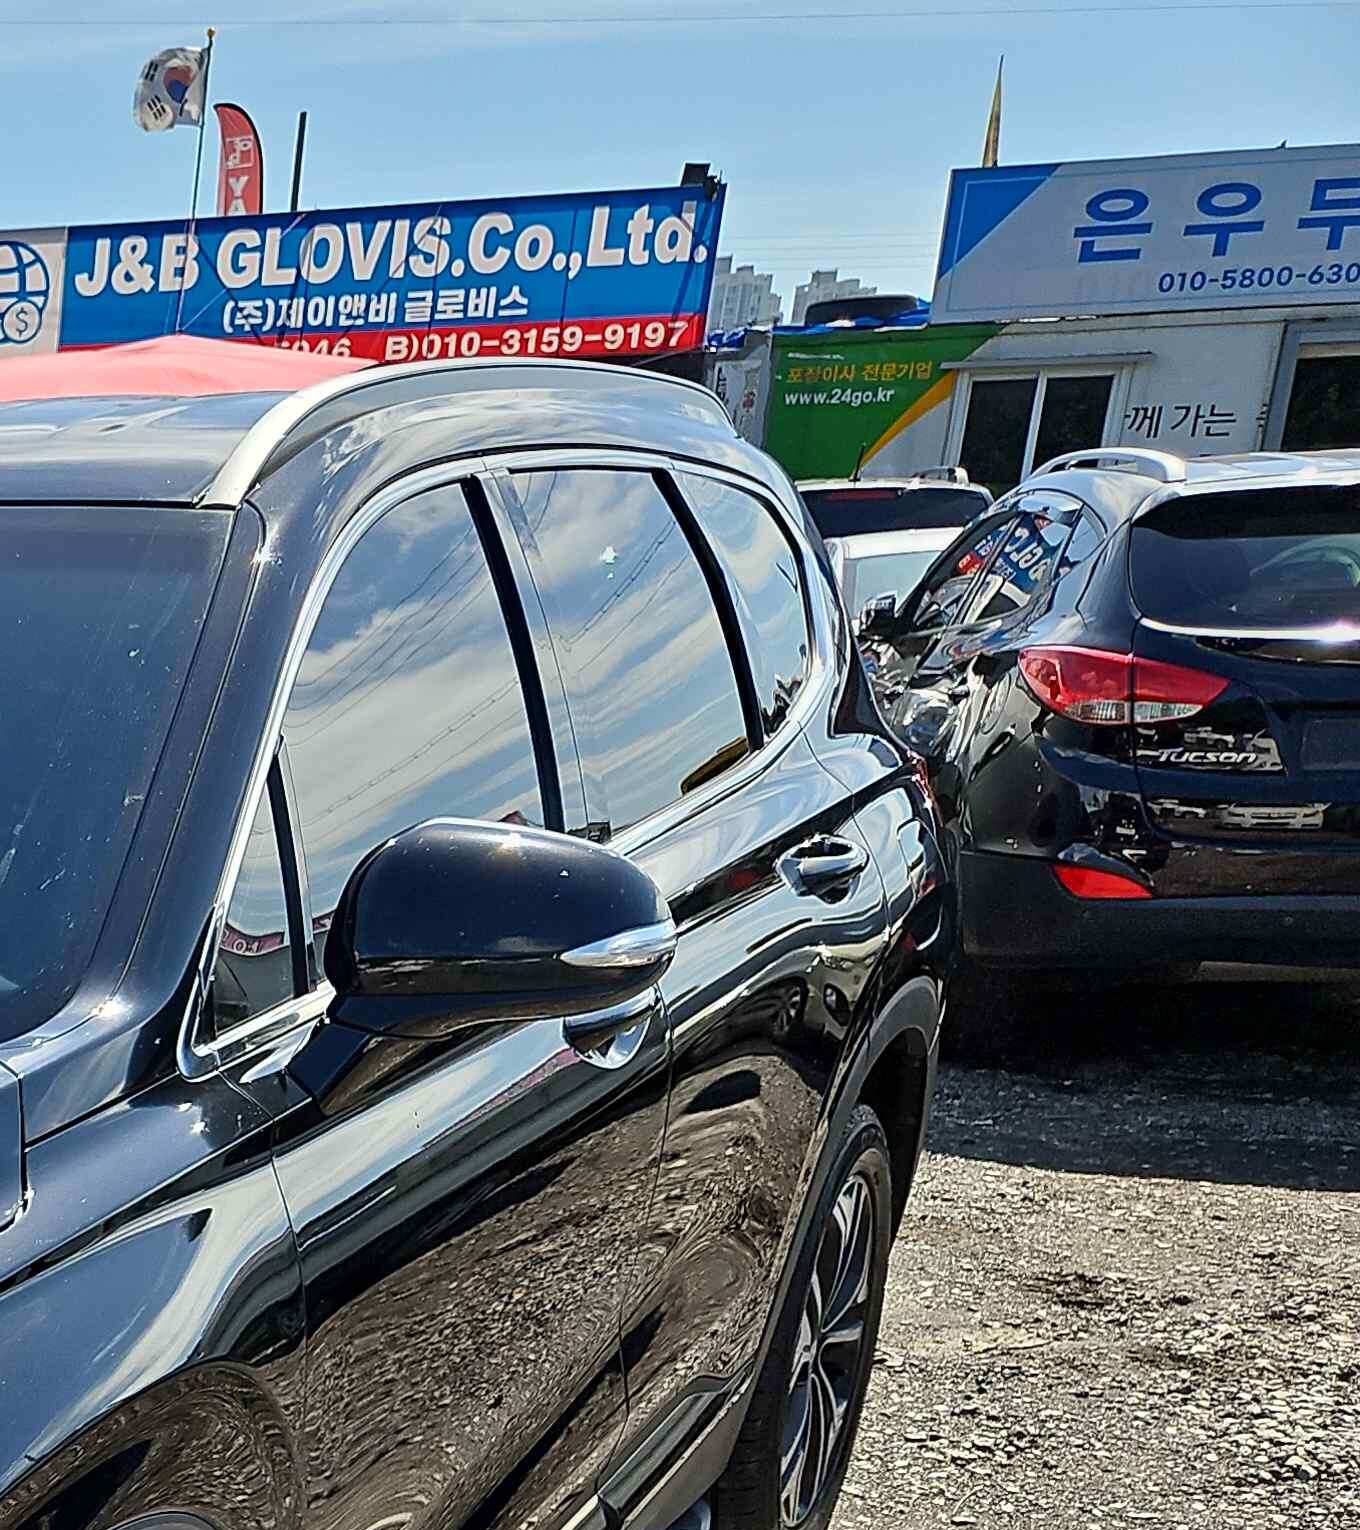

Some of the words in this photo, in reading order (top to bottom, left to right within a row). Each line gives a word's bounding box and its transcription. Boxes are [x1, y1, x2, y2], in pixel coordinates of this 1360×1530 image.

[74, 232, 202, 298] J&B
[223, 291, 398, 333] (주)제이앤비
[404, 284, 530, 324] 글로비스
[385, 320, 691, 363] B)010-3159-9197
[784, 387, 895, 406] www.24go.kr
[1125, 404, 1163, 438] 께
[1171, 404, 1237, 437] 가는
[1159, 748, 1257, 763] Tucson
